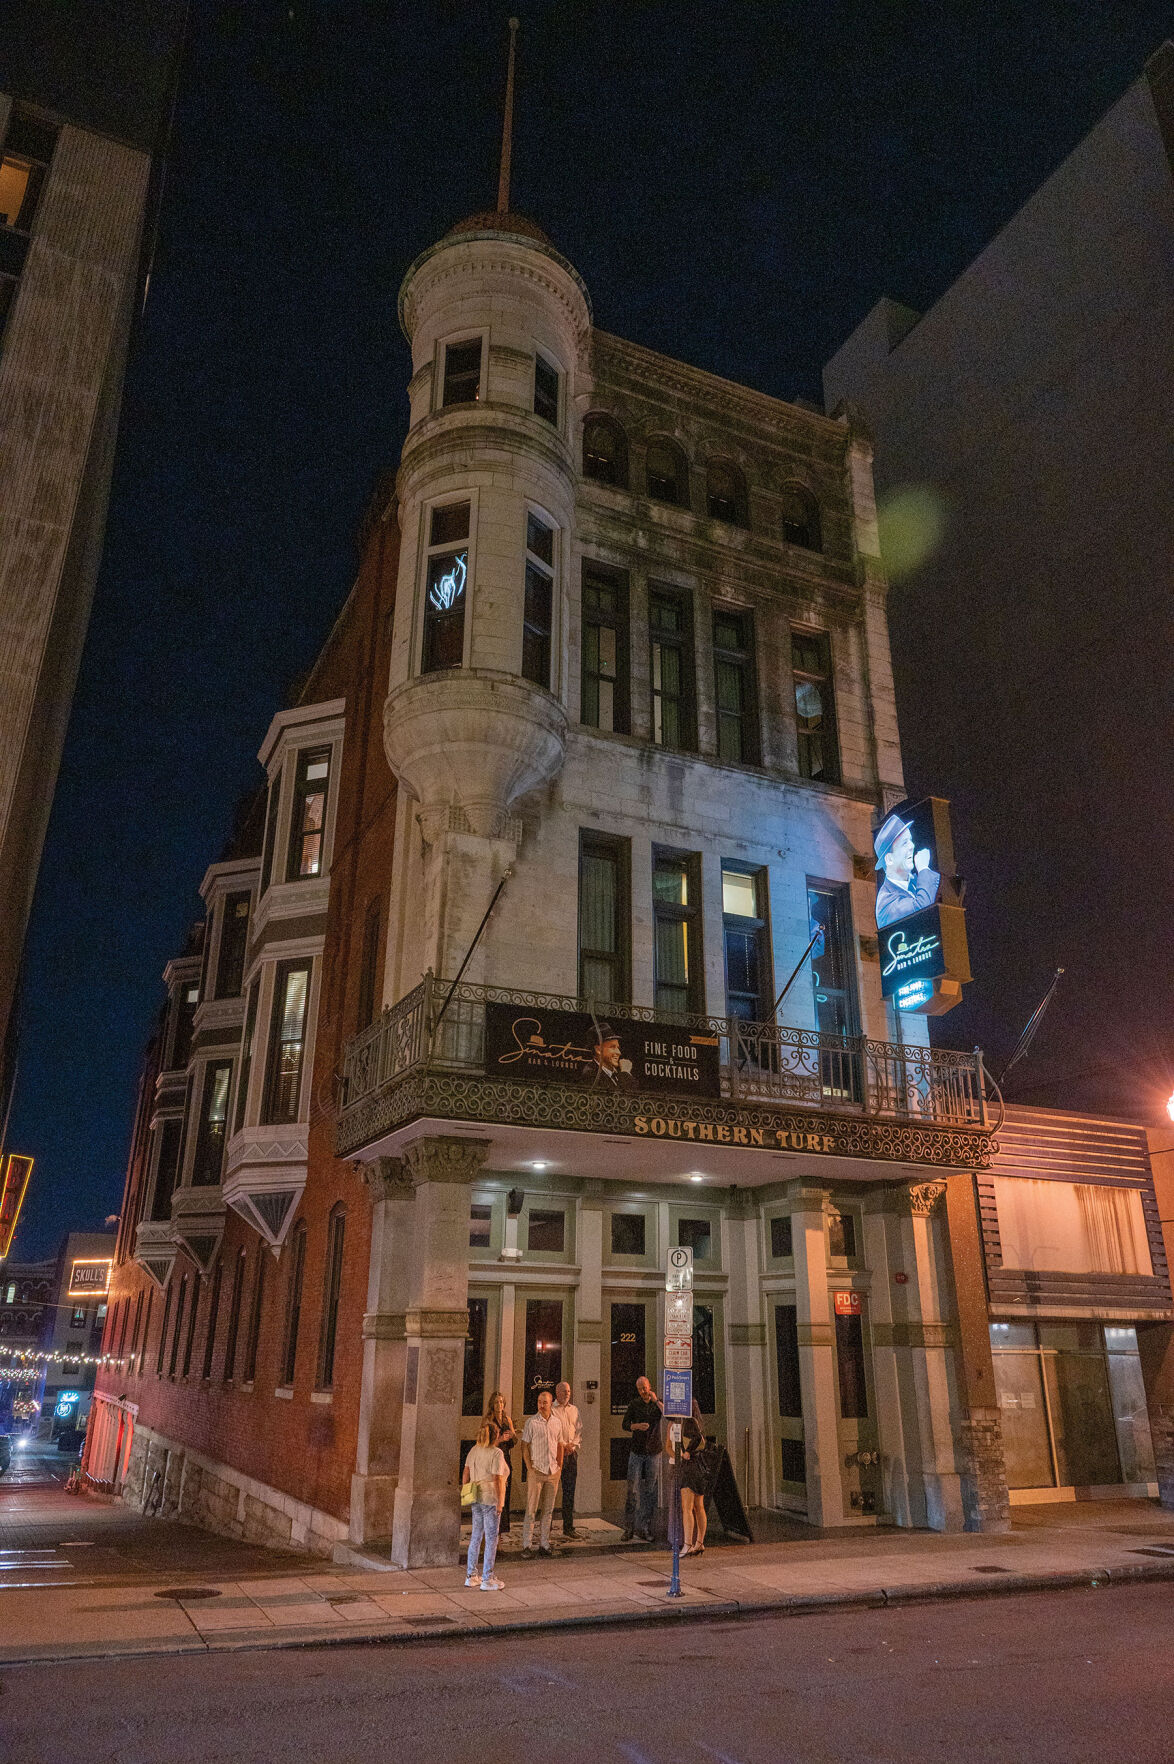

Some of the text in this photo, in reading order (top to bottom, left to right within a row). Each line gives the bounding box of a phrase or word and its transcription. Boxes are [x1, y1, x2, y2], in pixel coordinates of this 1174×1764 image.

[498, 1017, 593, 1064] Sinatra
[644, 1041, 697, 1060] FINE FOOD
[669, 1057, 675, 1065] &
[644, 1062, 699, 1081] COCKTAILS
[634, 1116, 836, 1152] SOUTHERN TURF
[676, 1252, 682, 1265] P
[75, 1268, 105, 1282] SKULL'S
[836, 1293, 858, 1305] FDC
[620, 1333, 636, 1342] 222
